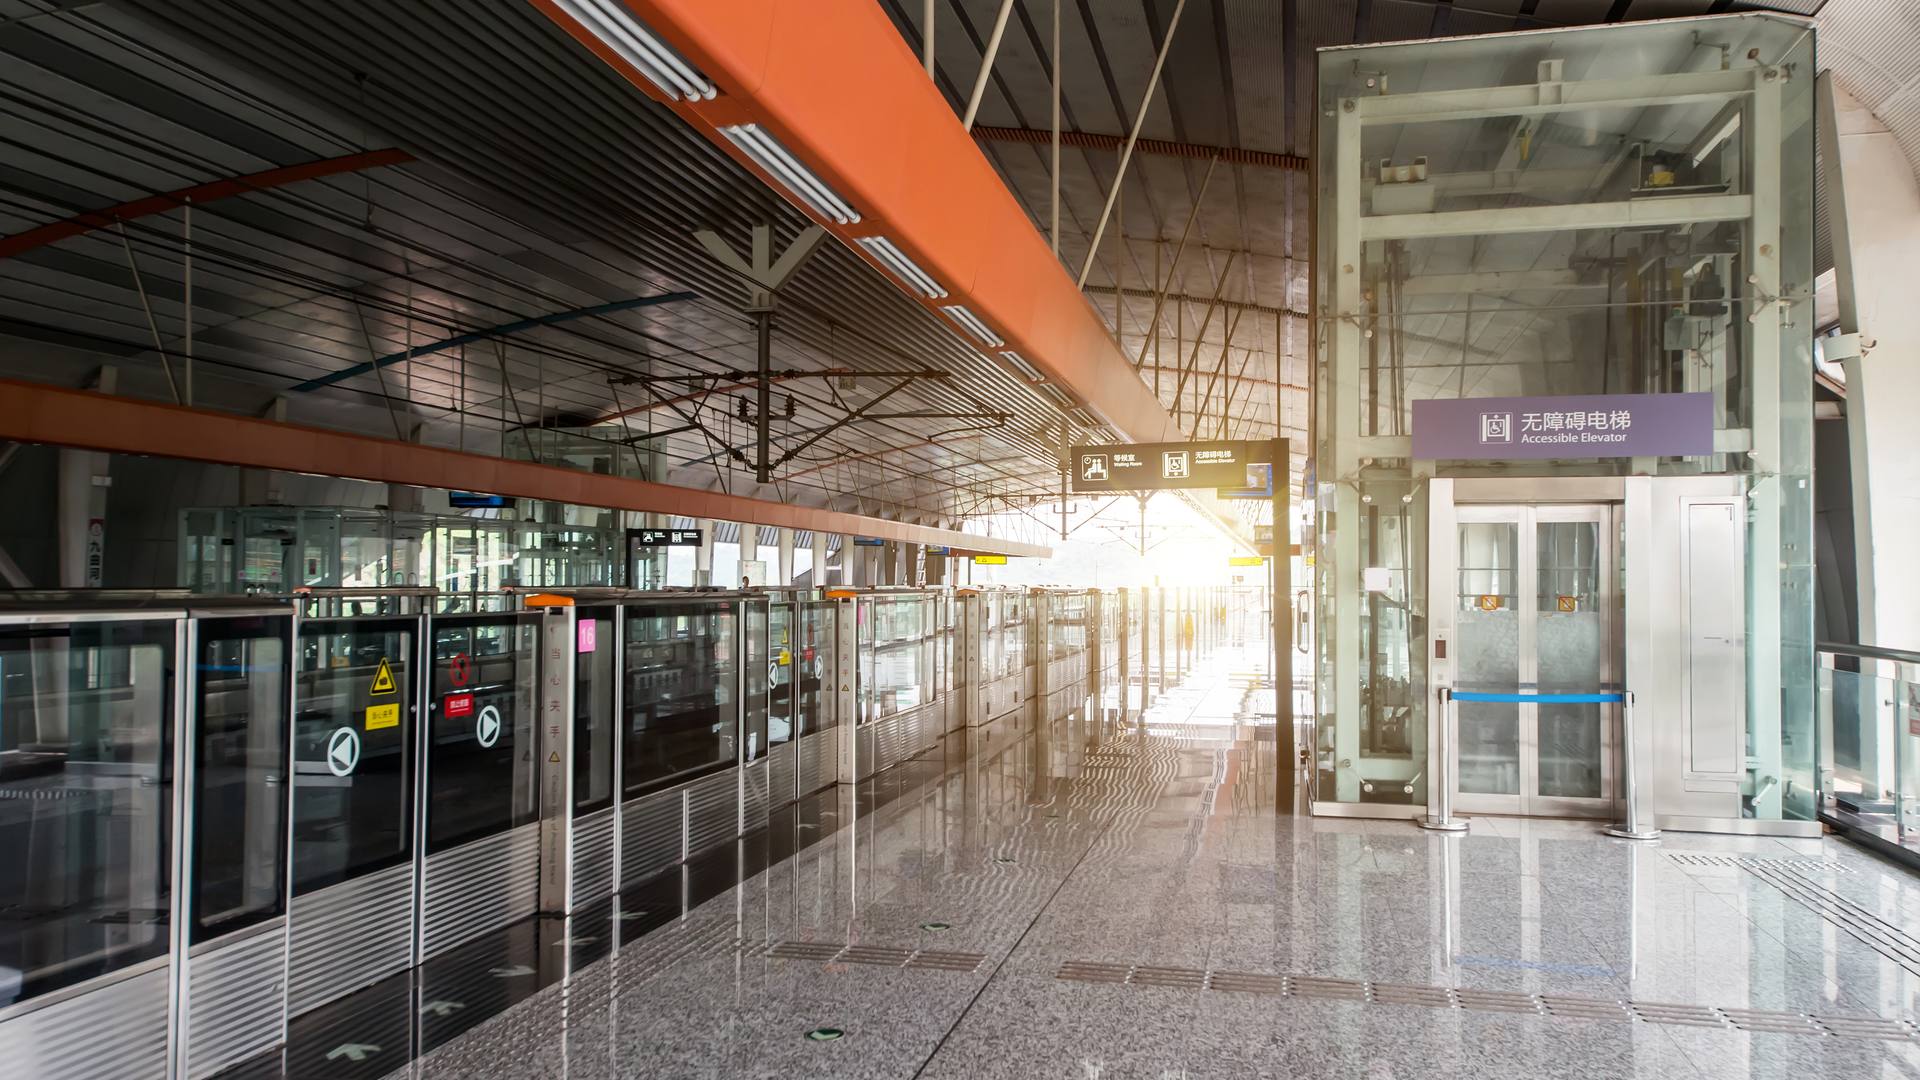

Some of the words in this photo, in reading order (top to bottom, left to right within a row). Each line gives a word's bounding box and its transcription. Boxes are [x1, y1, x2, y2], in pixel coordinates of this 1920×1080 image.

[1521, 410, 1631, 432] 无障碍电梯
[1521, 433, 1578, 444] Accessible
[1581, 432, 1627, 443] Elevator
[581, 626, 594, 645] 16
